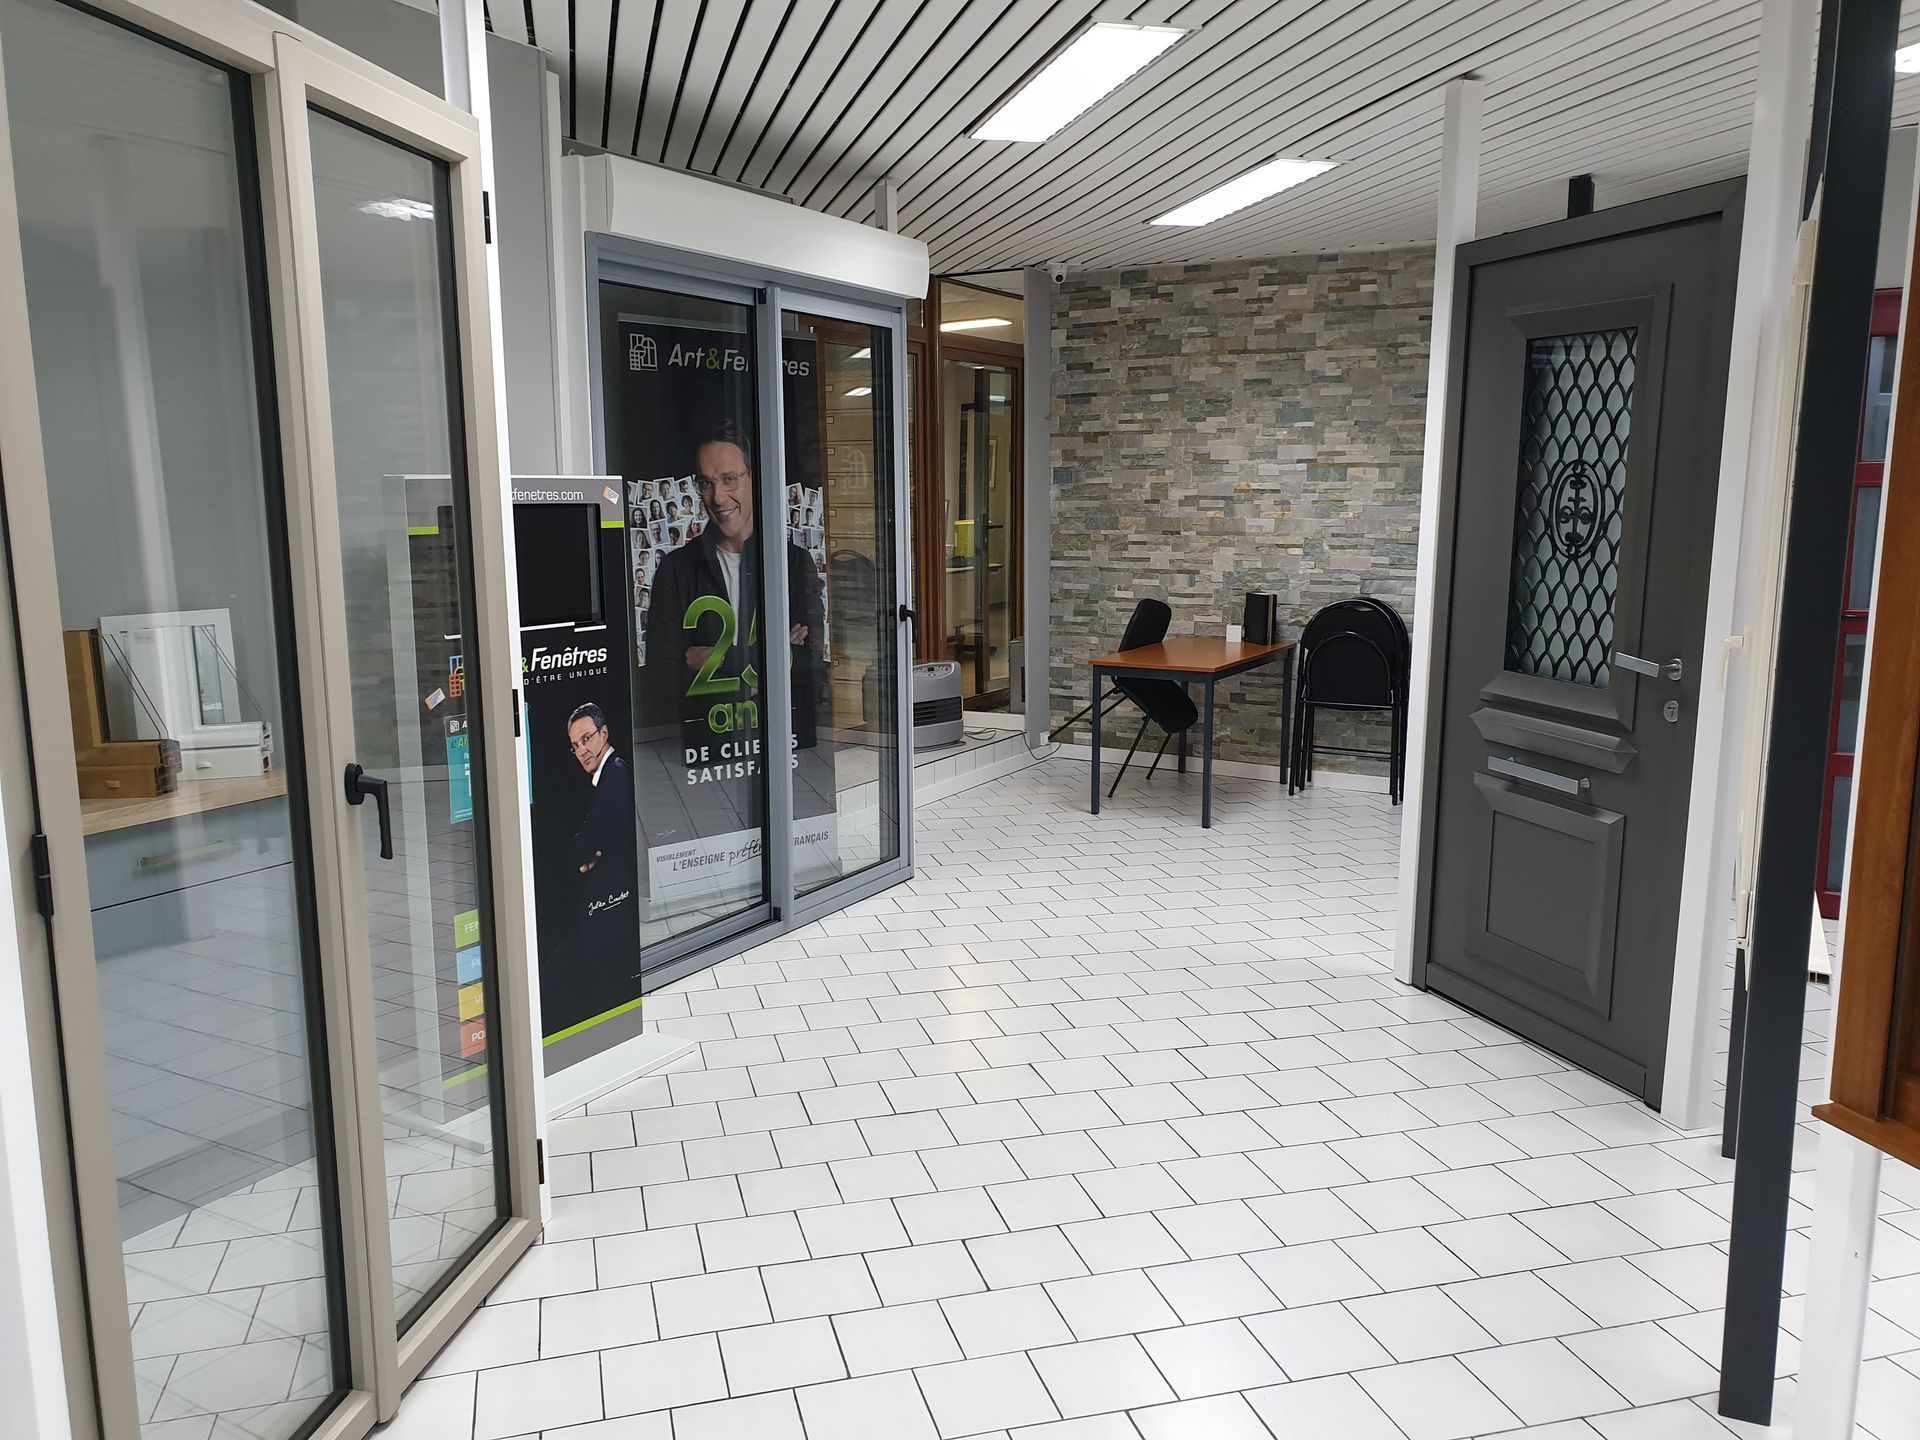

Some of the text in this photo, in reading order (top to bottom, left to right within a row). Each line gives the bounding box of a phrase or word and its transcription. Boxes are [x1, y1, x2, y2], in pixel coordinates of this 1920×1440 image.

[569, 666, 608, 679] UNIQUE
[685, 733, 799, 764] DE CLIES
[687, 752, 800, 786] SATISFS
[656, 849, 697, 863] VISIBLEMENT
[672, 851, 726, 872] L'ENSEIGNE
[793, 832, 829, 848] RANÇAIS
